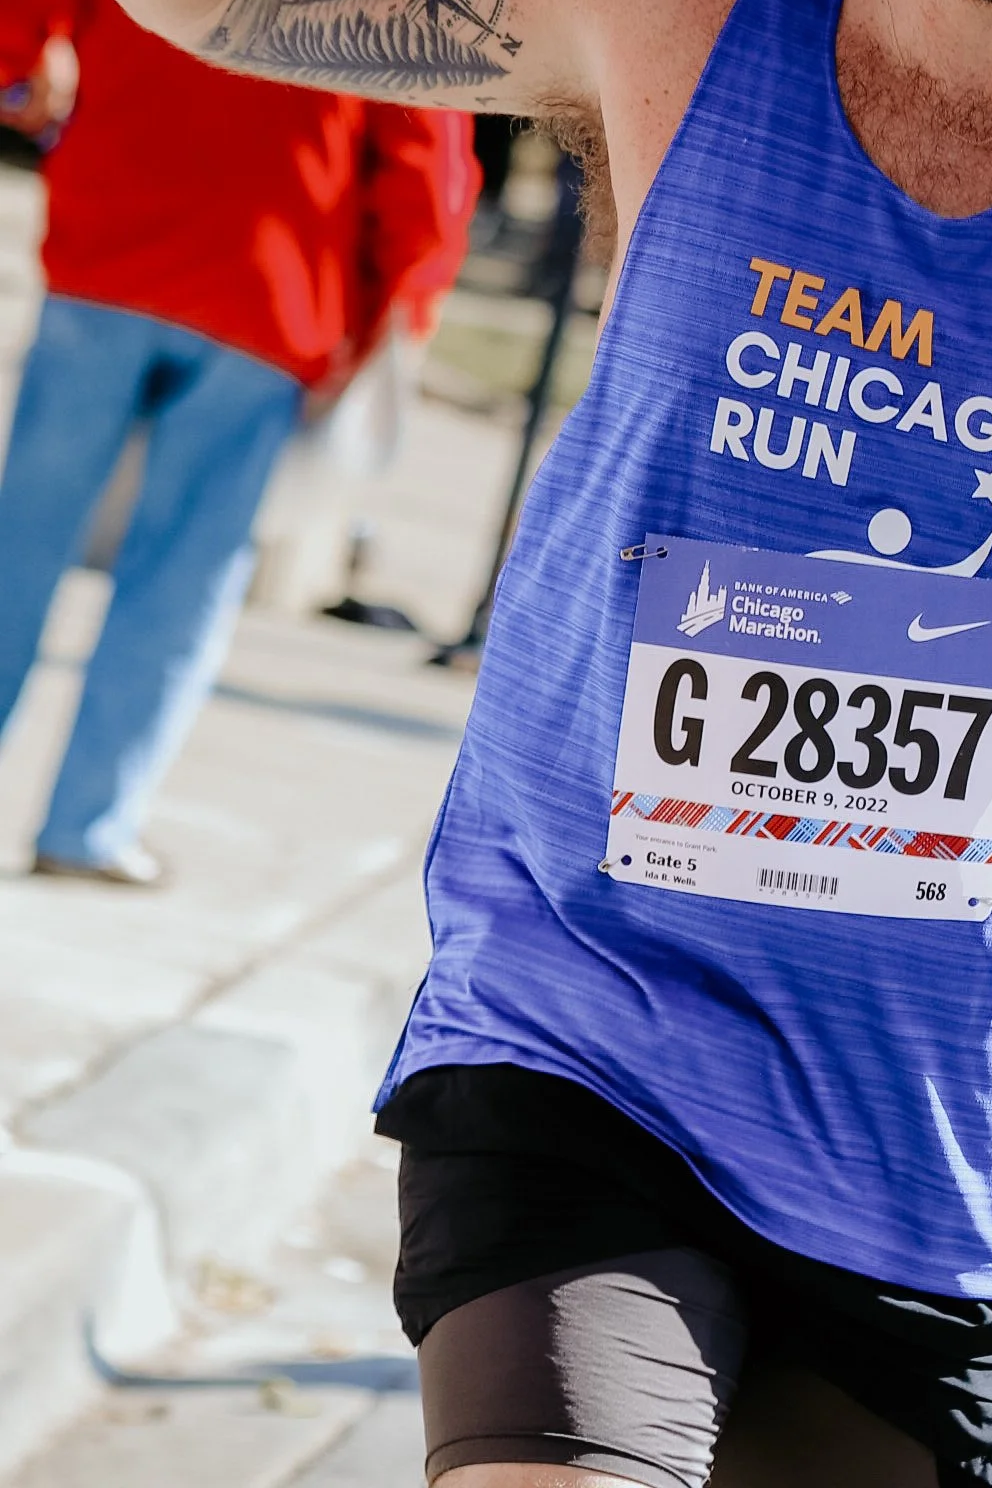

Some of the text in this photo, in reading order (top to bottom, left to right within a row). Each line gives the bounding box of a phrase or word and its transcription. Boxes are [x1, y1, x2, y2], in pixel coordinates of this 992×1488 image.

[499, 31, 524, 58] N
[749, 256, 935, 368] TEAM
[709, 395, 858, 487] RUN
[734, 581, 828, 603] BANK OF AMERICA
[731, 595, 804, 624] Chicago
[653, 658, 709, 767] G
[731, 781, 889, 813] OCTOBER 9, 2022
[646, 851, 698, 872] Gate 5
[645, 870, 696, 887] Ida B. Wells
[915, 881, 947, 901] 568
